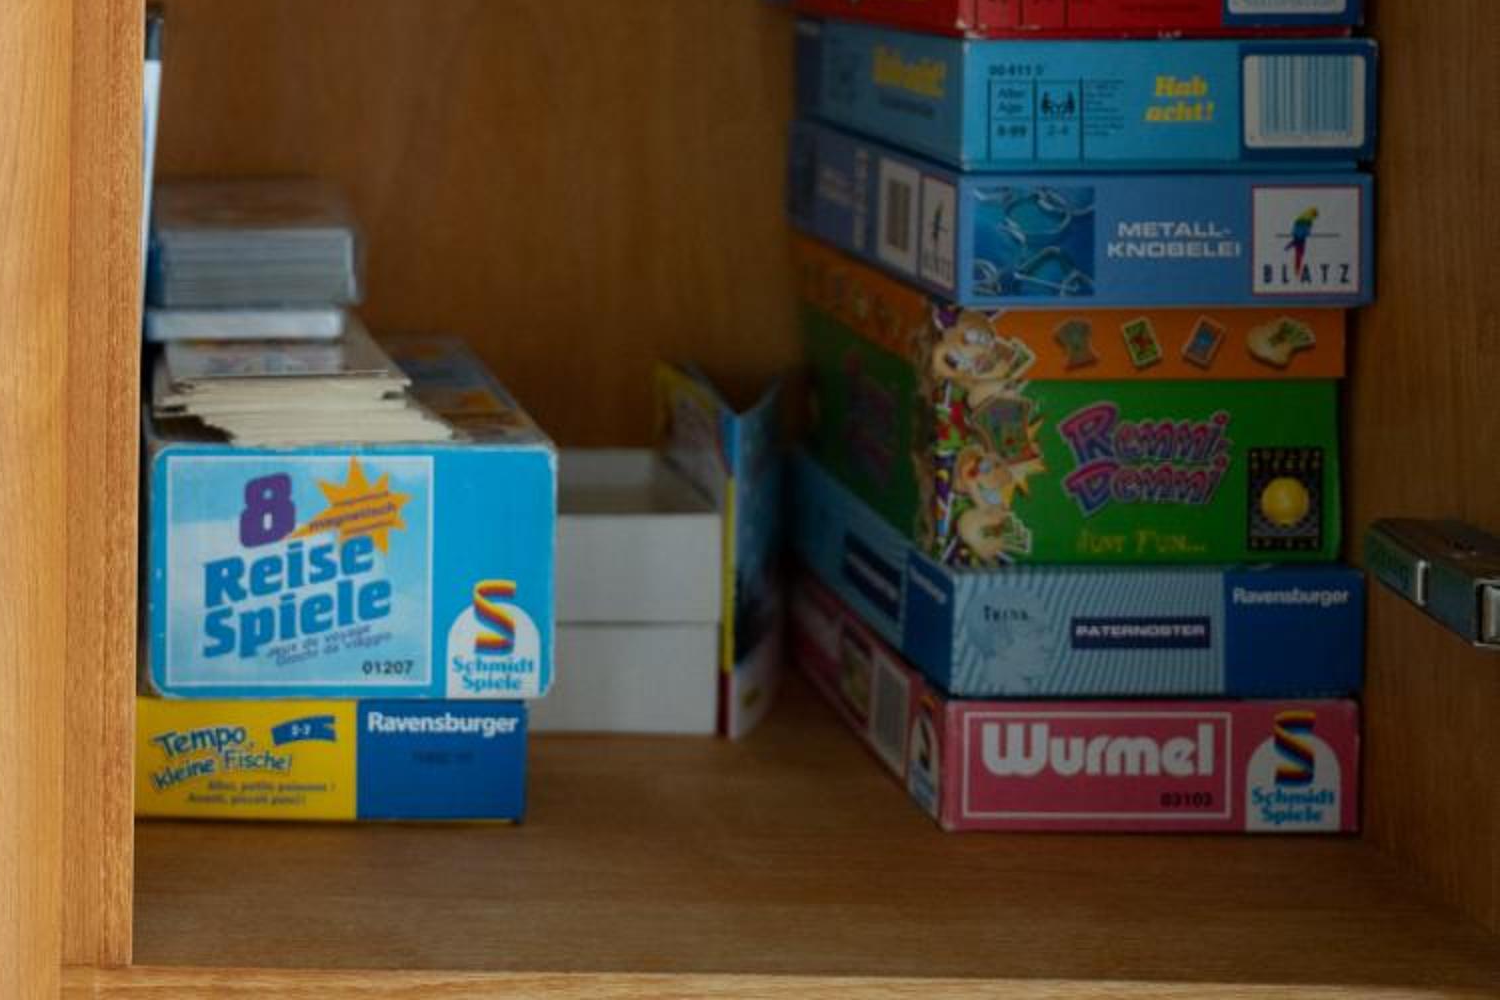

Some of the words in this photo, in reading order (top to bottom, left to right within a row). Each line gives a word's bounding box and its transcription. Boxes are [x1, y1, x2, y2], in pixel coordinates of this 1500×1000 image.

[1154, 76, 1208, 98] Hab
[1144, 100, 1214, 123] acht!
[1117, 221, 1230, 239] METALL-
[1106, 240, 1241, 258] KNOBELEI
[1262, 263, 1352, 285] BLATZ
[240, 473, 296, 548] 8
[203, 535, 375, 608] Reise
[1232, 586, 1349, 606] Ravensburger
[203, 577, 392, 659] Spiele
[1075, 624, 1206, 639] PATERNOSTER
[361, 660, 414, 676] 01207
[451, 655, 535, 675] Schmidt
[461, 673, 521, 694] Spiele
[367, 711, 520, 738] Ravensburger
[154, 724, 255, 760] Tempo,
[980, 722, 1215, 777] Wurmel
[152, 758, 216, 791] kleine
[223, 749, 293, 772] Fische!
[1251, 787, 1334, 808] Schmidt
[1260, 806, 1323, 825] Spiele
